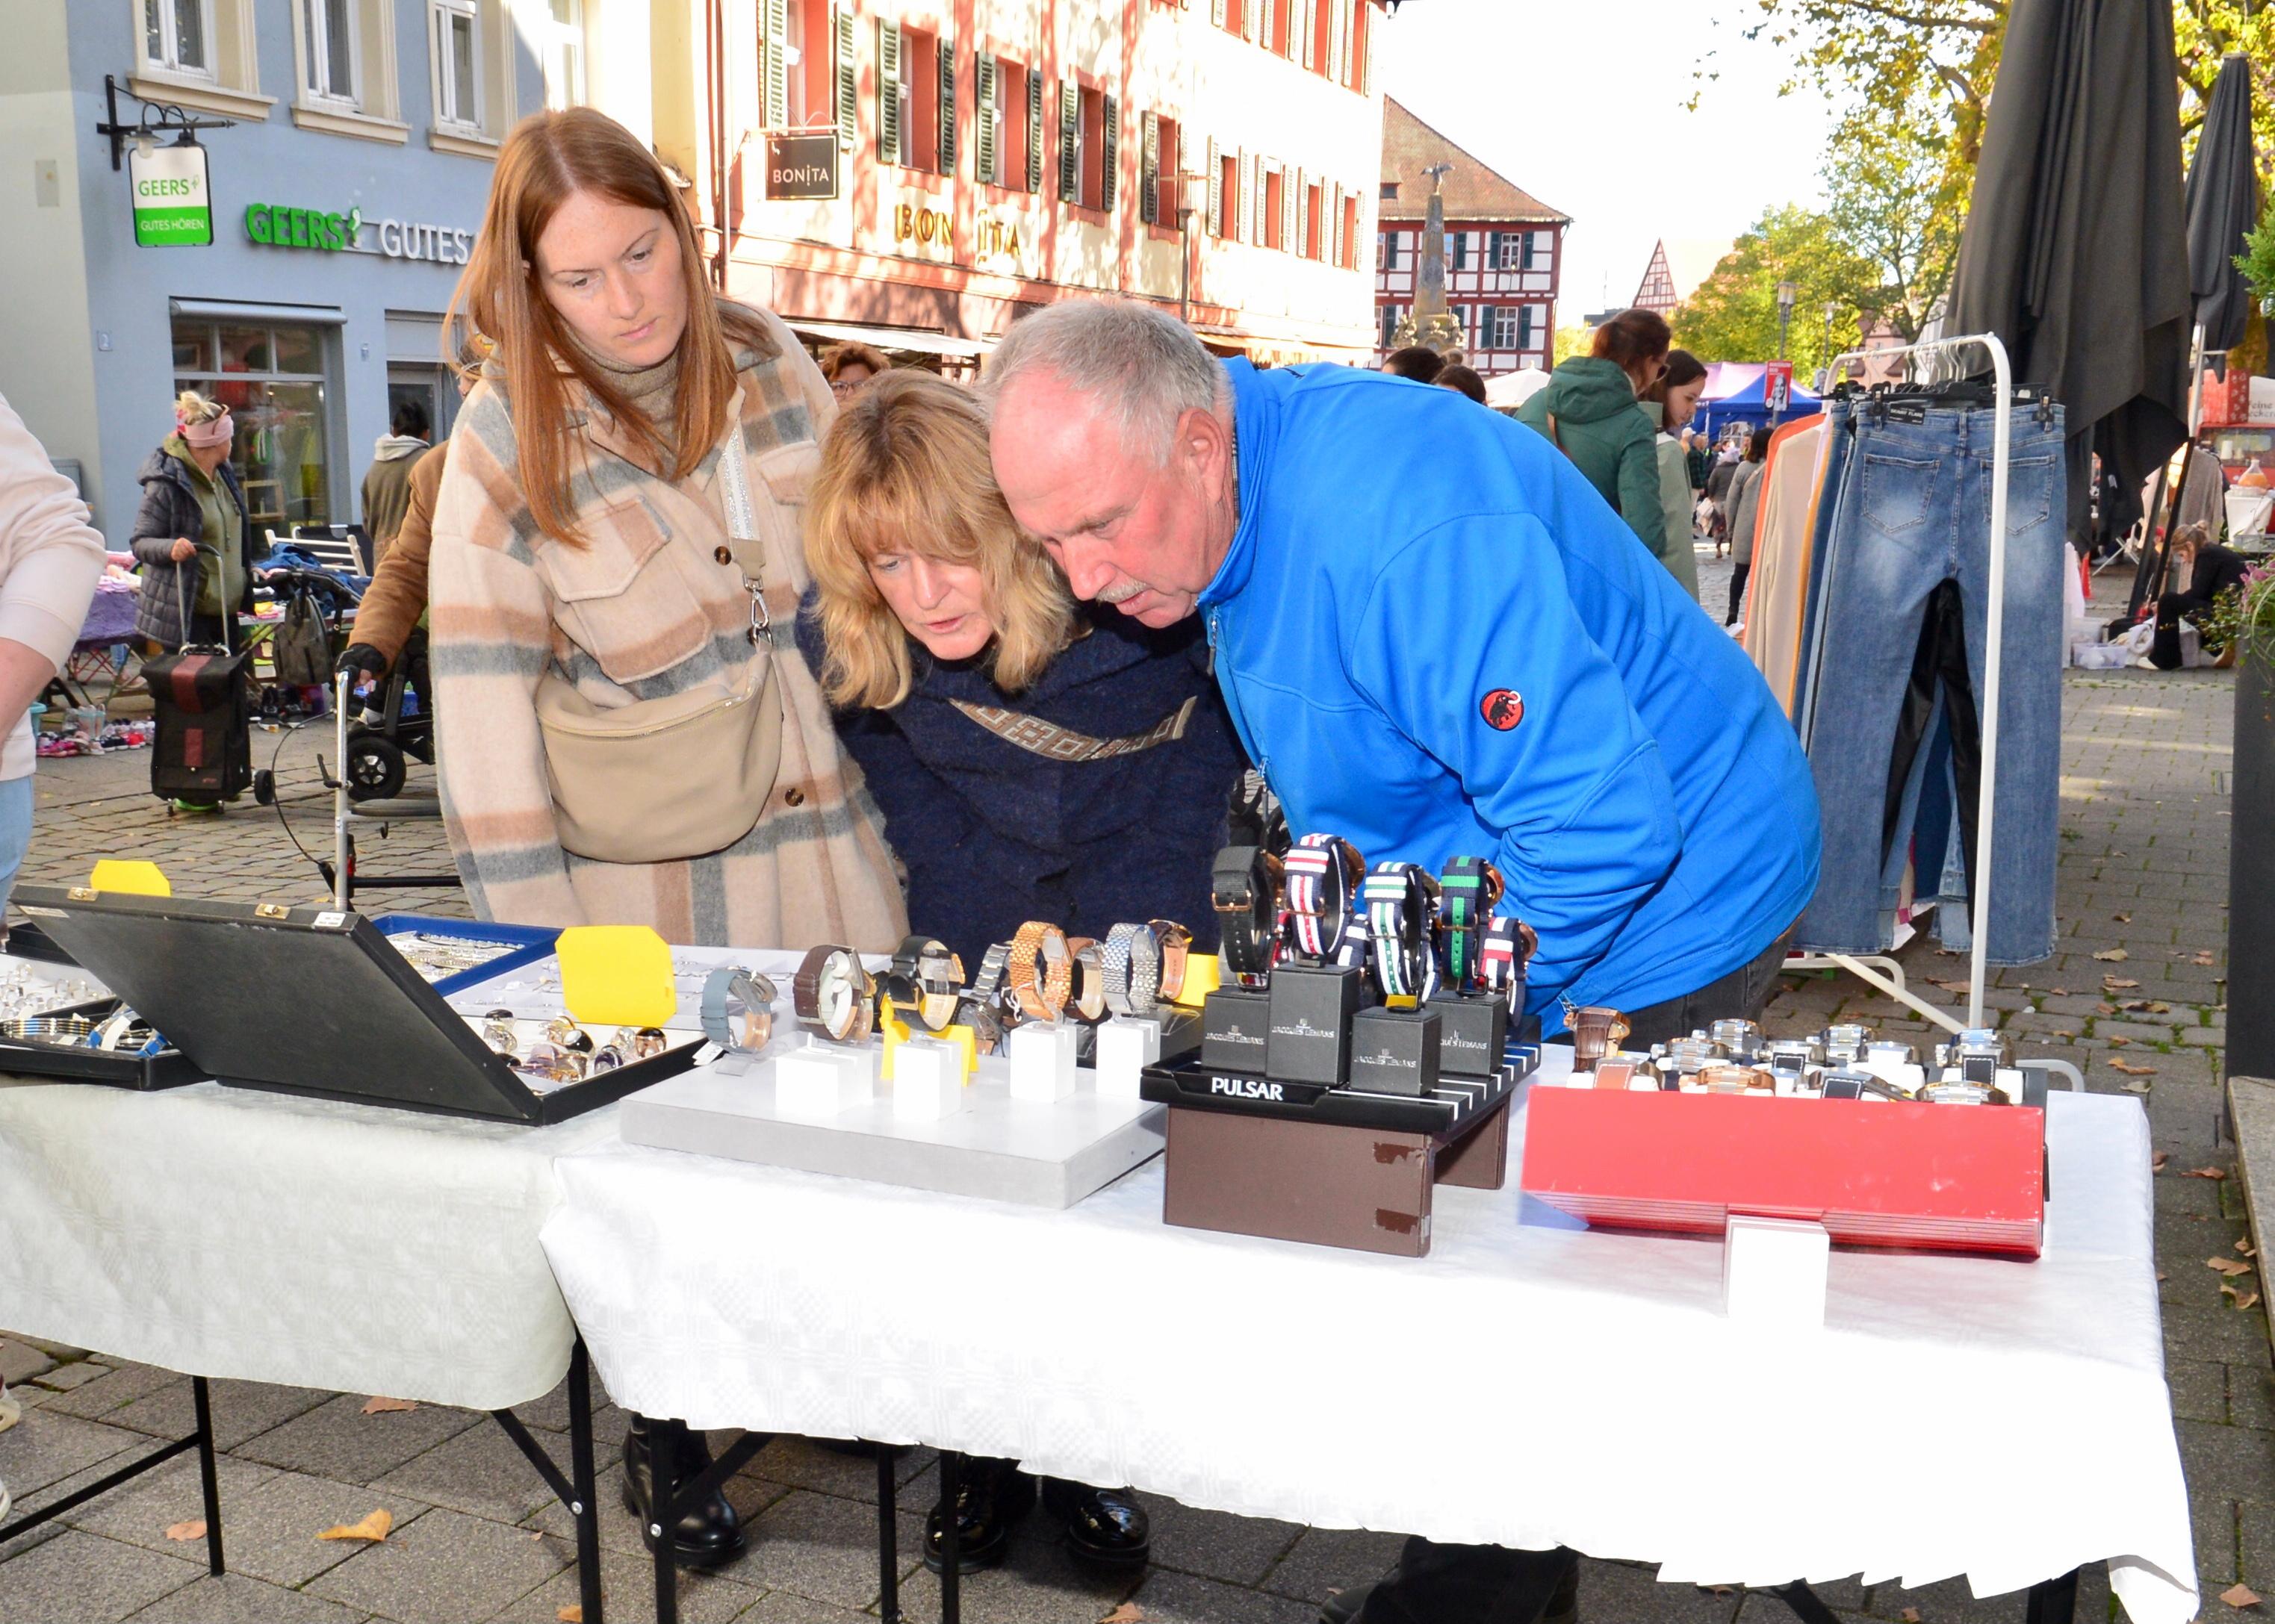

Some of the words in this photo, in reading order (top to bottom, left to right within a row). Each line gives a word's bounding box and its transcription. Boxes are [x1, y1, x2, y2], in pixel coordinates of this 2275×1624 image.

[139, 179, 190, 196] GEERS
[141, 220, 170, 231] GUTES
[173, 217, 205, 230] HÖREN
[246, 203, 345, 252] GEERS
[379, 218, 469, 265] GUTES
[1211, 1077, 1283, 1101] PULSAR
